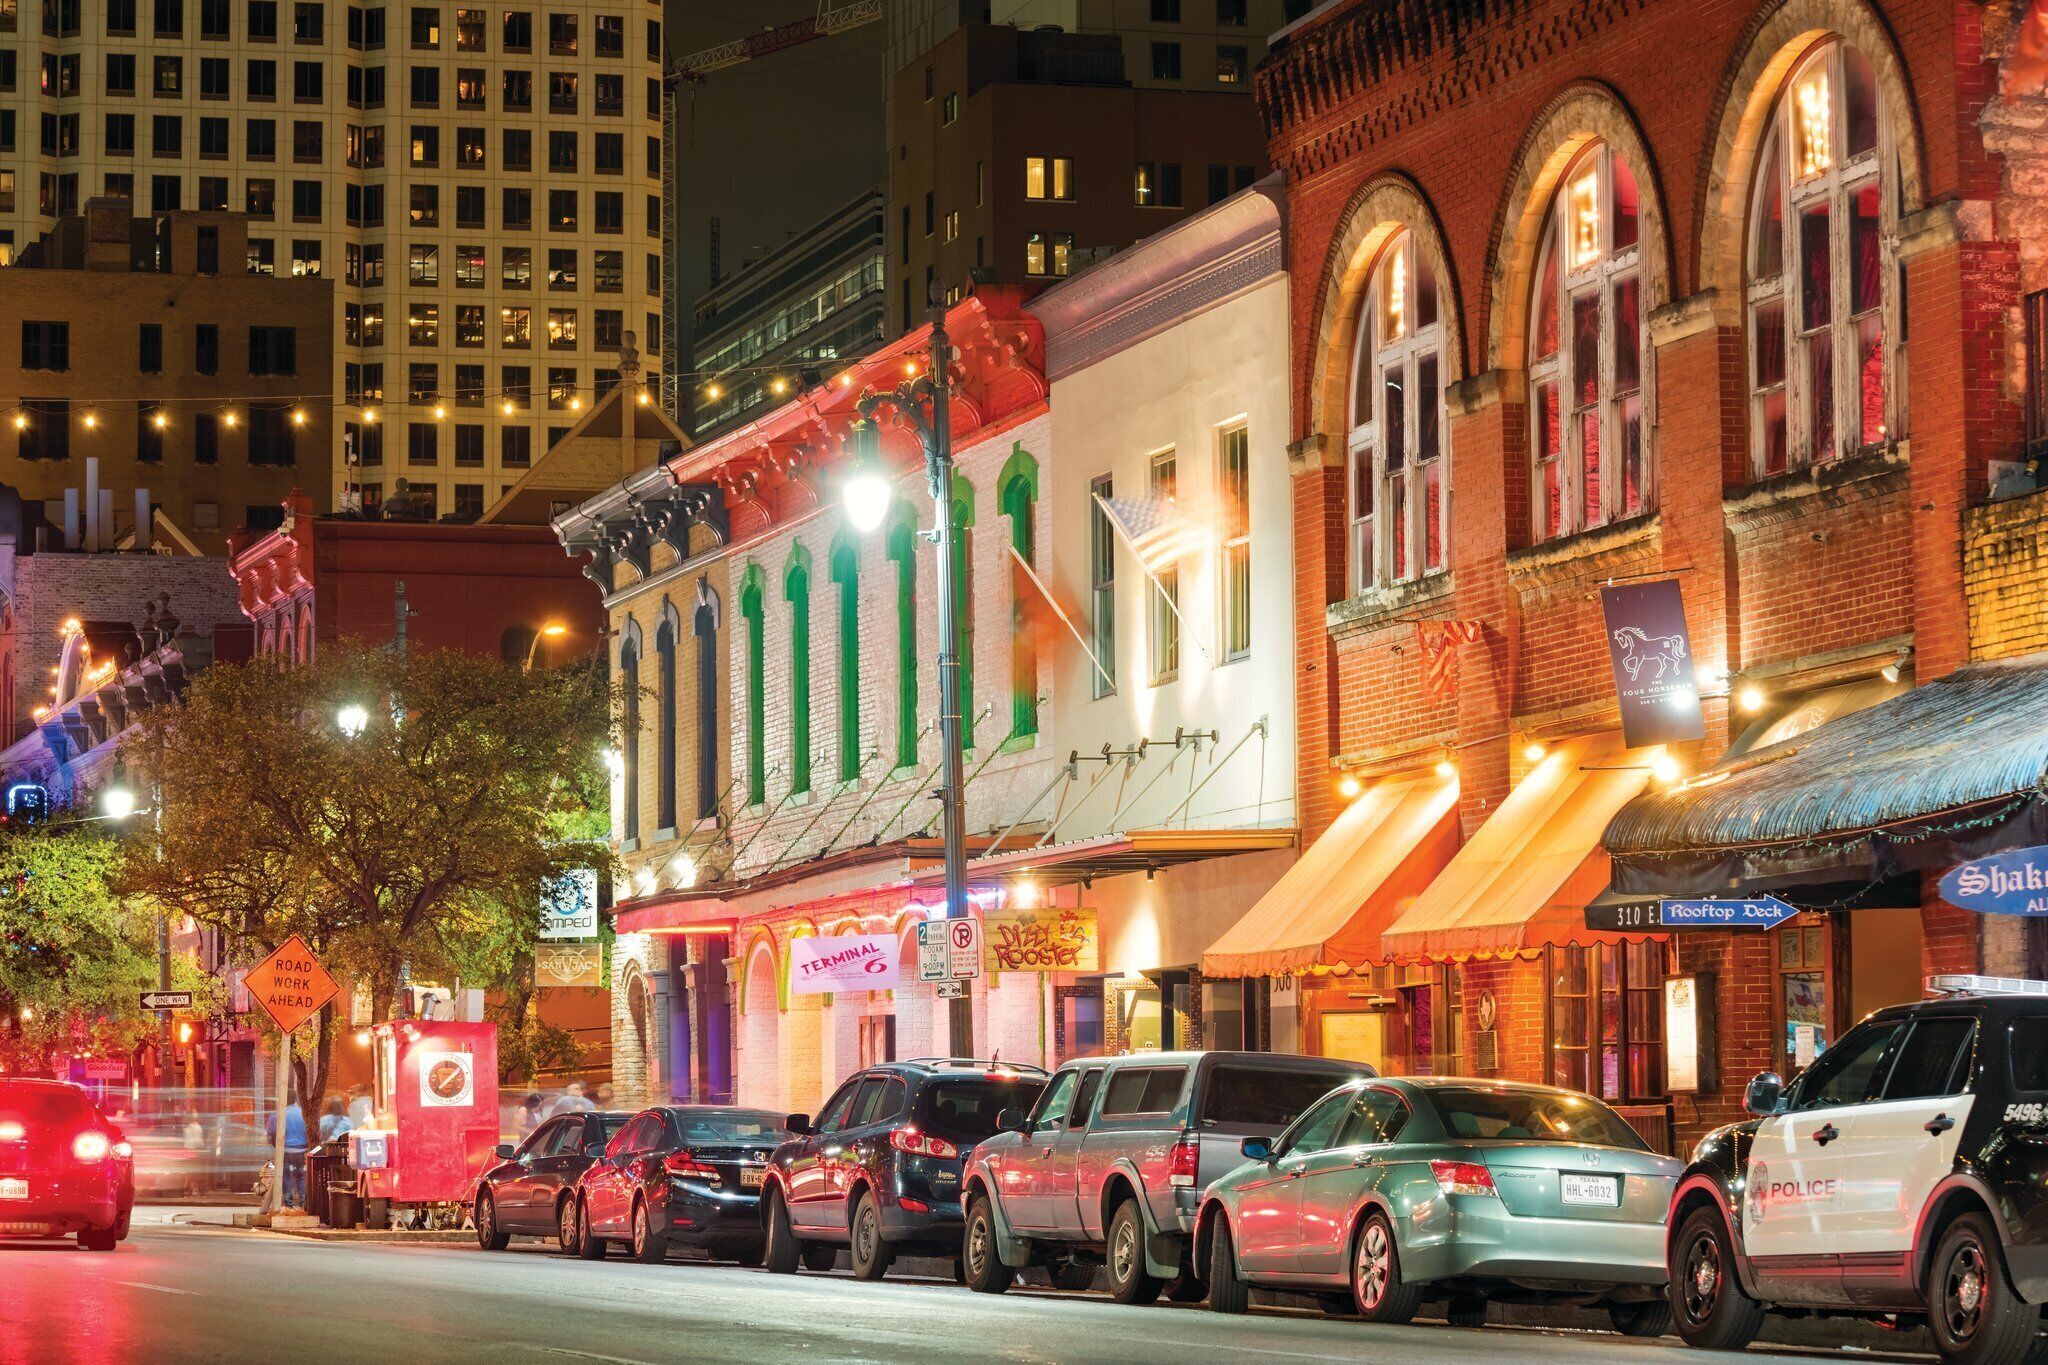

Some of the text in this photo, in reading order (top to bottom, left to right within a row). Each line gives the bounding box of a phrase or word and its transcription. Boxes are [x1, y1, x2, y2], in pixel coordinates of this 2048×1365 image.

[1623, 689, 1645, 697] FOUR
[1668, 904, 1783, 920] Rooftop Deck
[2026, 898, 2048, 912] AL
[1617, 907, 1640, 926] 310
[919, 926, 926, 942] 2
[928, 933, 945, 941] PARKING
[923, 946, 944, 954] 7:00AM
[801, 942, 880, 974] TERMINAL
[864, 956, 888, 974] 6
[929, 954, 937, 962] TO
[275, 959, 312, 973] ROAD
[541, 961, 593, 970] SAN JAC
[923, 962, 945, 971] 9:00PM
[273, 976, 310, 990] WORK
[268, 994, 313, 1008] AHEAD
[2003, 1103, 2042, 1122] 5496
[1771, 1179, 1836, 1197] POLICE
